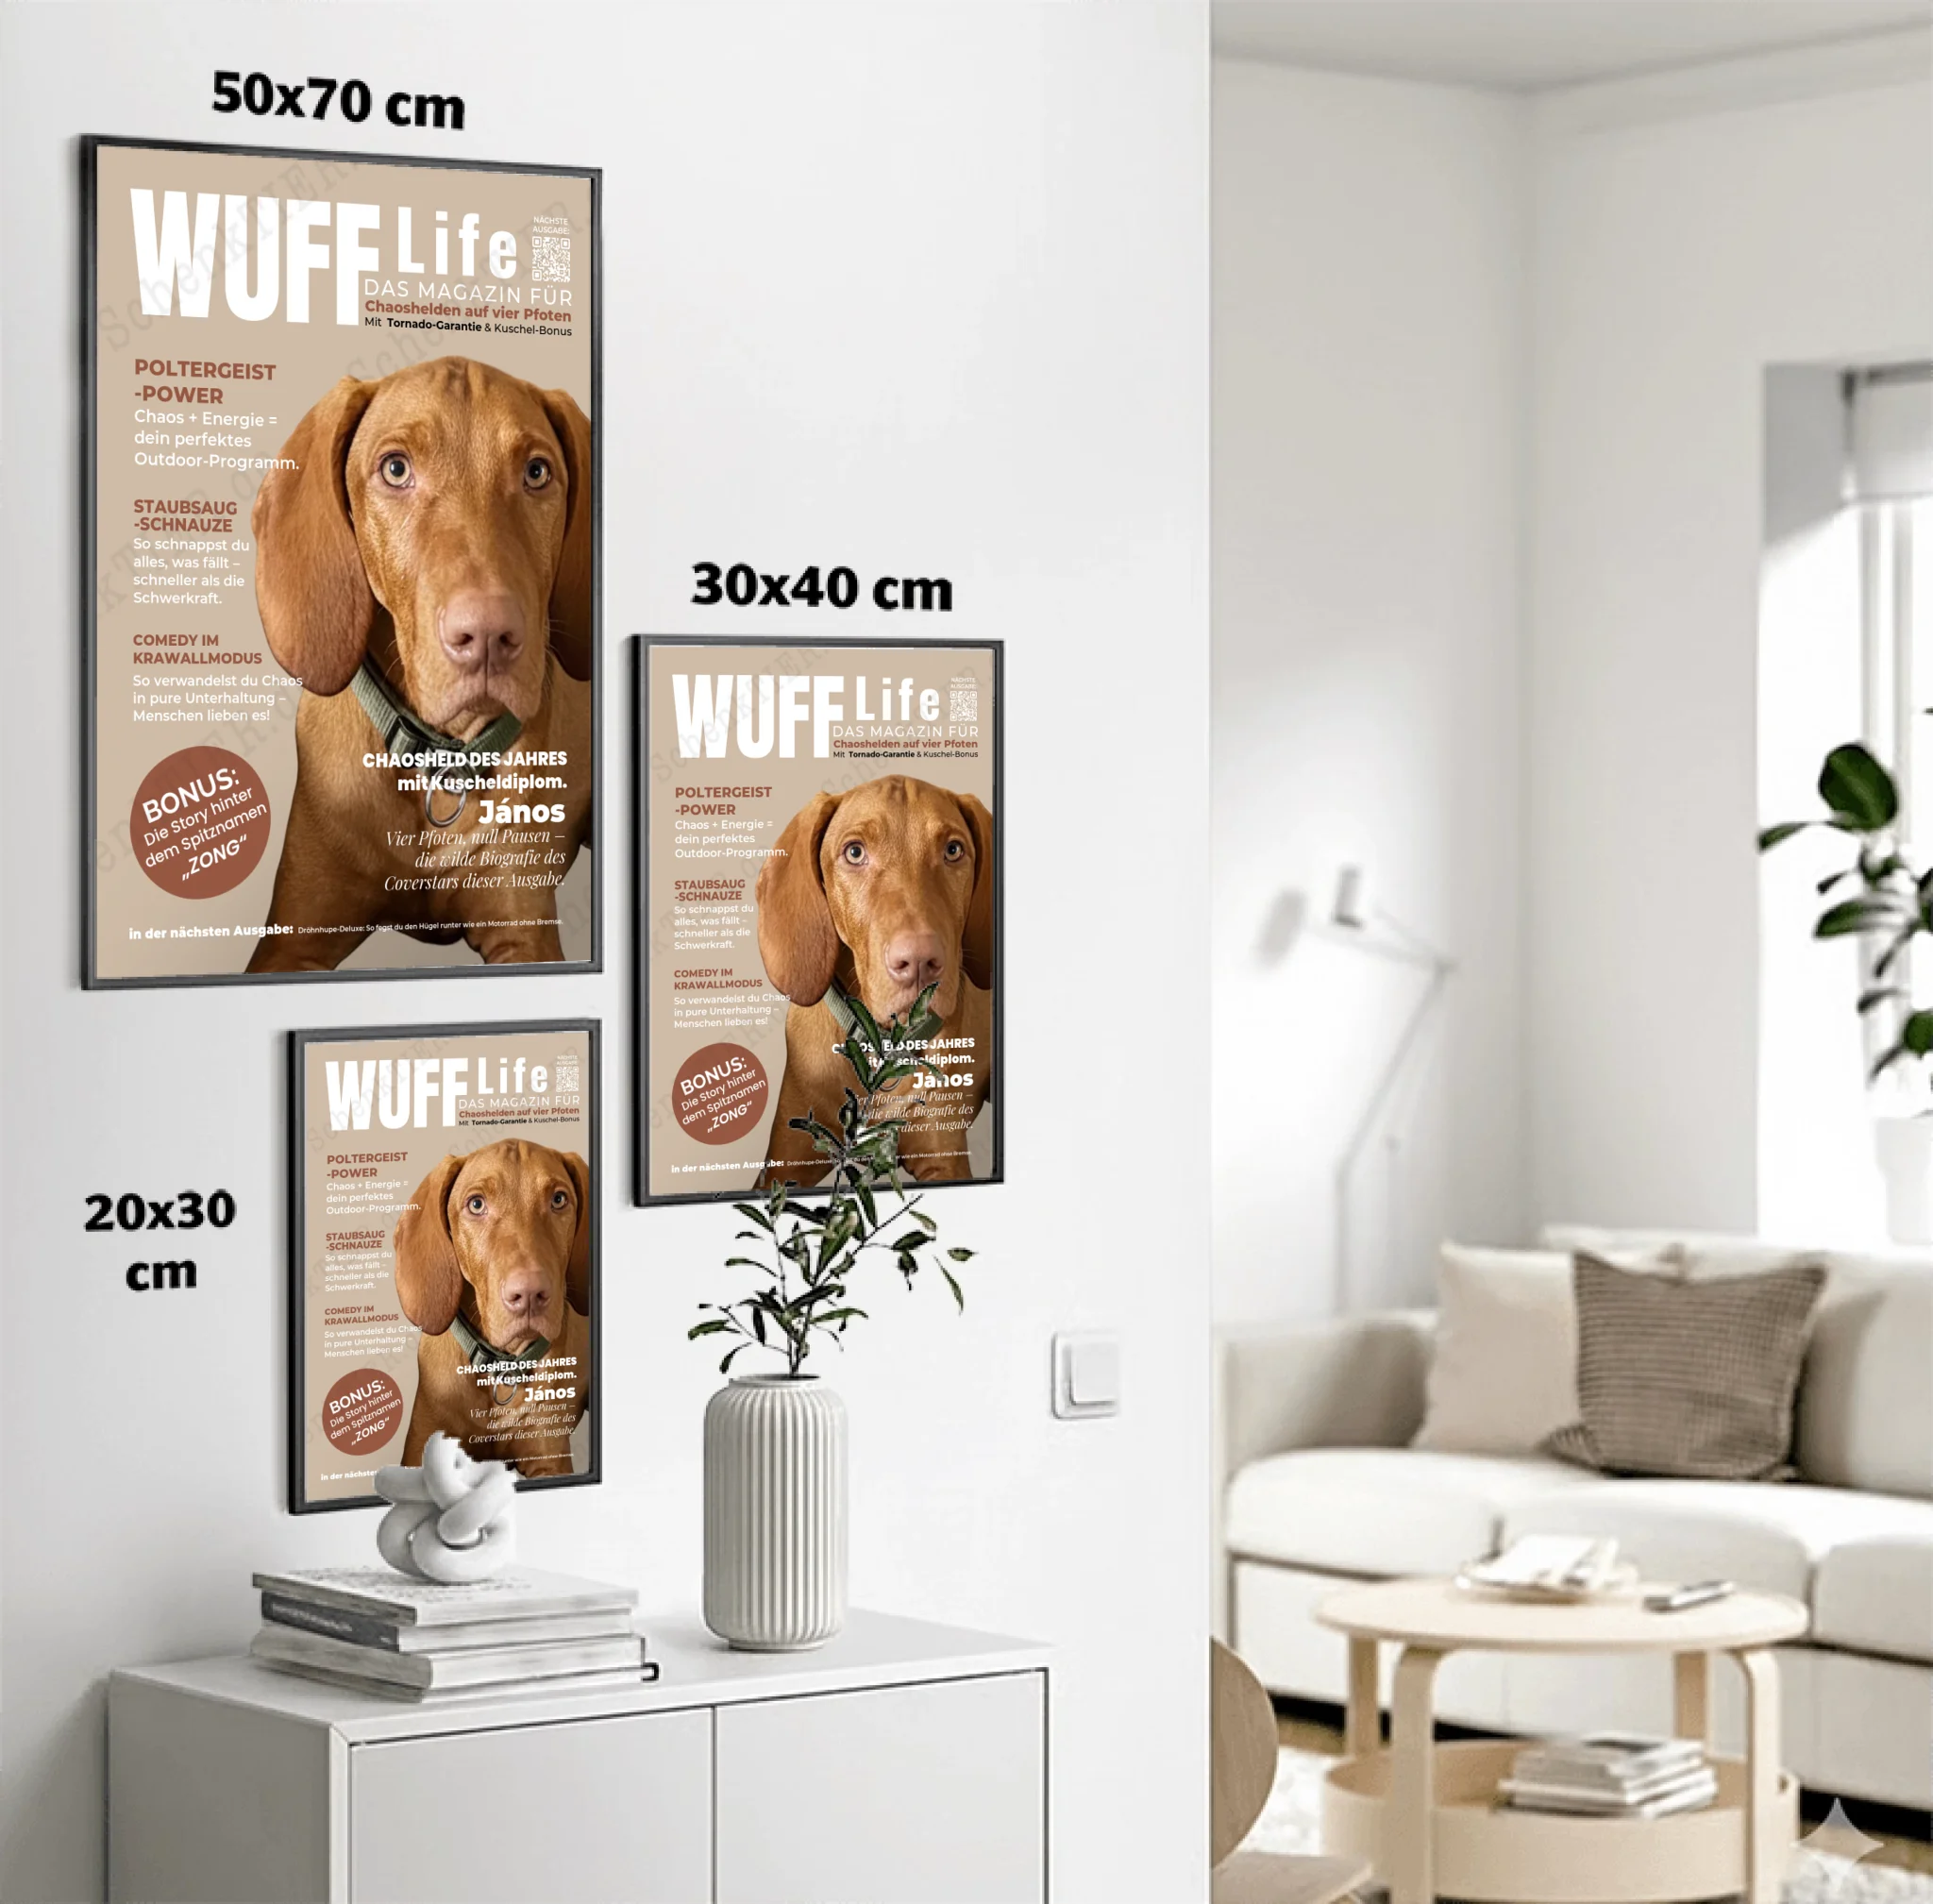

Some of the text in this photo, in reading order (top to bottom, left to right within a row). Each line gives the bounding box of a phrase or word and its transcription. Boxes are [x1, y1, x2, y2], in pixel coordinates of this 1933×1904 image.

[532, 215, 568, 226] NÄCHSTE
[532, 226, 570, 235] AUSGABE:
[130, 188, 517, 326] WUFF Life
[364, 278, 572, 306] DAS MAGAZIN FÜR
[365, 299, 572, 323] Chaoshelden auf vier Pfoten
[364, 317, 573, 336] Mit Tornado-Garantie & Kuschel-Bonus
[134, 359, 277, 380] POLTERGEIST
[134, 385, 224, 404] -POWER
[134, 409, 184, 424] Chaos
[189, 413, 197, 422] +
[203, 412, 264, 430] Energie
[134, 430, 252, 448] dein perfektes
[134, 452, 299, 471] Outdoor-Programm.
[133, 498, 237, 515] STAUBSAUG
[134, 517, 233, 532] -SCHNAUZE
[133, 538, 249, 552] So schnappst du
[134, 556, 229, 570] alles, was fällt
[133, 574, 244, 587] schneller als die
[133, 591, 222, 604] Schwerkraft.
[133, 634, 219, 647] COMEDY IM
[133, 652, 262, 665] KRAWALLMODUS
[133, 674, 303, 686] So verwandelst du Chaos
[133, 692, 276, 706] in pure Unterhaltung
[133, 709, 270, 722] Menschen lieben es!
[672, 674, 939, 758] WUFF Life
[833, 724, 978, 737] DAS MAGAZIN FÜR
[903, 739, 919, 748] auf
[362, 751, 567, 767] CHAOSHELD DES JAHRES
[397, 773, 567, 794] mit Kuscheldiplom.
[142, 767, 240, 823] BONUS:
[676, 786, 772, 798] POLTERGEIST
[143, 787, 252, 847] Die Story hinter
[478, 798, 565, 824] János
[676, 804, 735, 816] -POWER
[145, 803, 267, 868] dem Spitznamen
[386, 828, 550, 849] Vier Pfoten, null Pausen
[675, 834, 755, 846] dein perfektes
[415, 849, 565, 868] die wilde Biografie des
[675, 848, 787, 859] Outdoor-Programm.
[384, 871, 565, 891] Coverstars dieser Ausgabe.
[675, 880, 746, 889] STAUBSAUG
[675, 891, 742, 901] -SCHNAUZE
[128, 923, 293, 939] in der nächsten Ausgabe:
[298, 925, 365, 935] Dröhnhupe-Deluxe:
[405, 922, 417, 931] den
[419, 921, 439, 932] Hügel
[440, 921, 461, 930] runter
[487, 919, 517, 928] Motorrad
[537, 918, 563, 926] Bremse.
[675, 969, 718, 978] COMEDY
[675, 980, 762, 990] KRAWALLMODUS
[680, 1057, 748, 1095] BONUS:
[326, 1057, 547, 1131] WUFF Life
[681, 1070, 756, 1110] Die Story hinter
[459, 1094, 580, 1108] DAS MAGAZIN FÜR
[683, 1080, 766, 1124] dem Spitznamen
[459, 1109, 514, 1118] Chaoshelden
[328, 1153, 408, 1164] POLTERGEIST
[328, 1168, 378, 1178] -POWER
[671, 1164, 680, 1173] in
[699, 1162, 741, 1171] nächsten
[327, 1230, 385, 1241] STAUBSAUG
[327, 1240, 382, 1251] -SCHNAUZE
[326, 1306, 361, 1315] COMEDY
[325, 1314, 398, 1325] KRAWALLMODUS
[456, 1356, 577, 1374] CHAOSHELD DES JAHRES
[478, 1371, 577, 1386] mit Kuscheldiplom.
[328, 1380, 385, 1414] BONUS:
[524, 1386, 575, 1402] János
